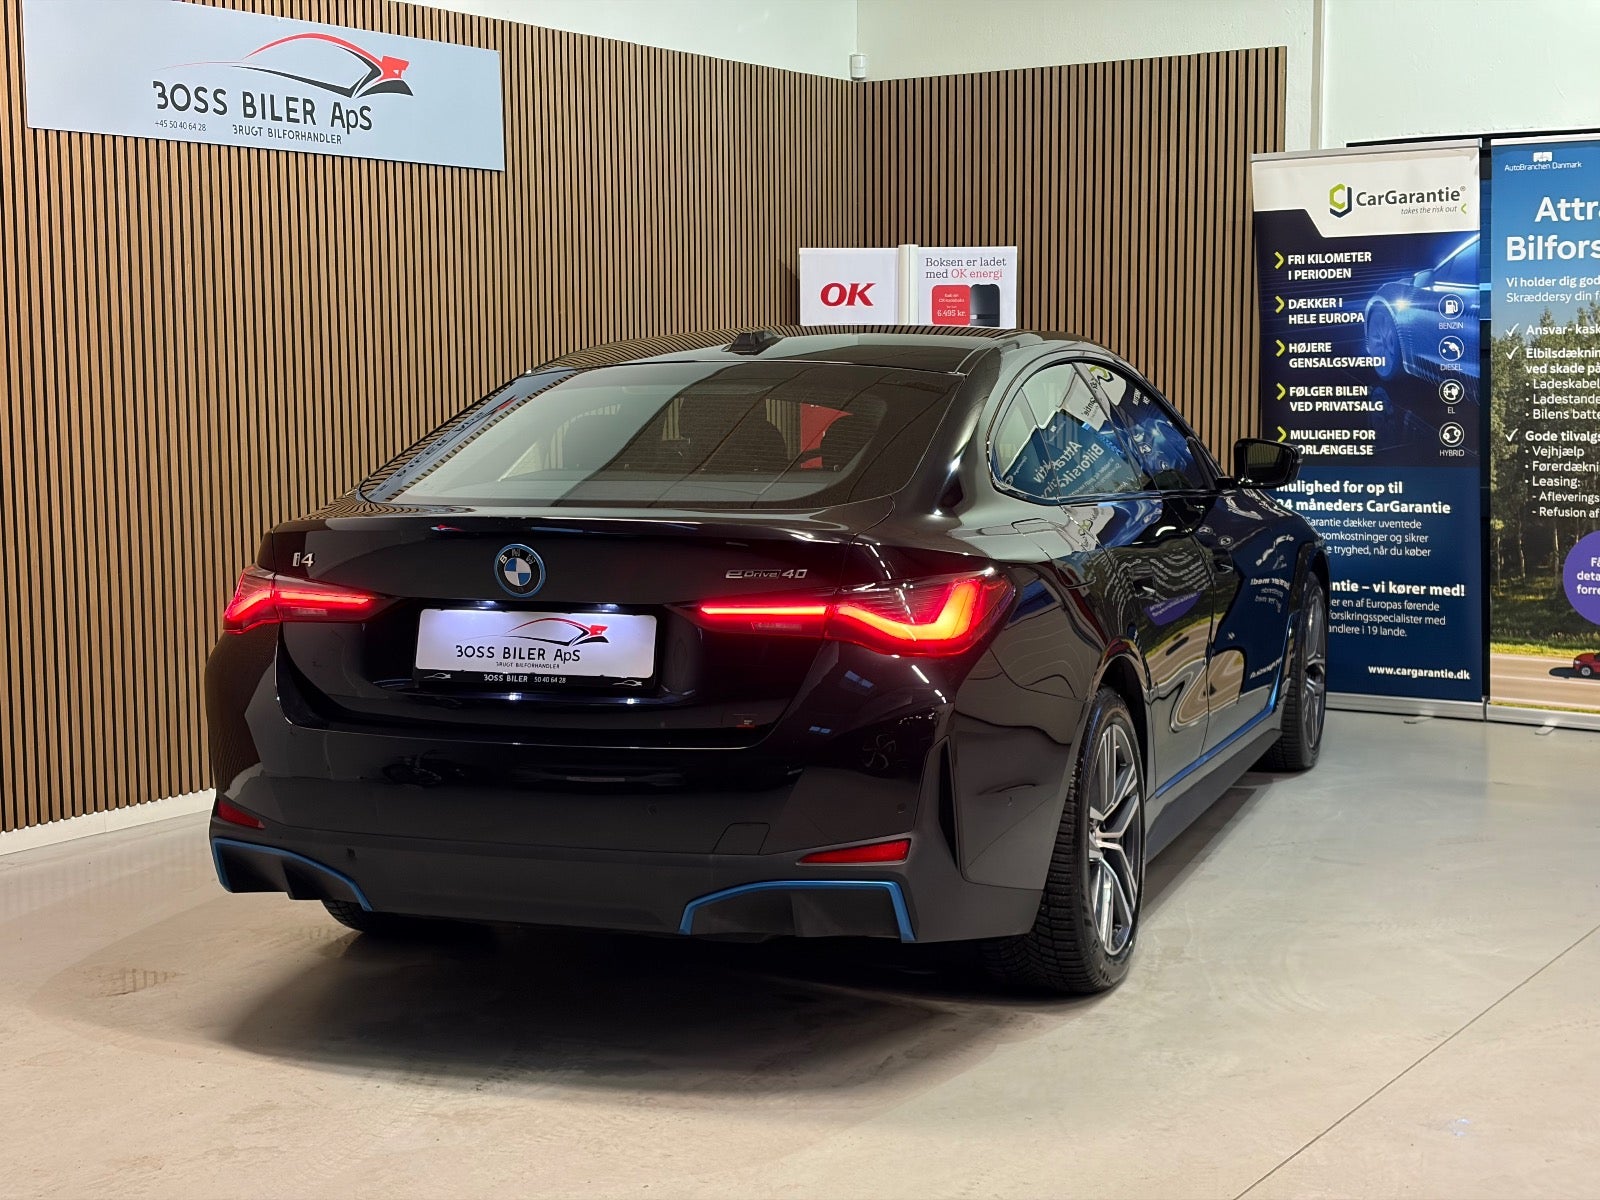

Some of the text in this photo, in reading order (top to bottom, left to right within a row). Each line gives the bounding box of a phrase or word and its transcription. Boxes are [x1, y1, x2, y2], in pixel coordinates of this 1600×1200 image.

[242, 91, 317, 126] BILER
[330, 101, 373, 135] ApS
[169, 120, 178, 129] 50
[178, 121, 187, 130] 40
[188, 122, 197, 131] 64
[198, 123, 207, 132] 28
[268, 127, 342, 145] BILFORHANDLER
[1504, 161, 1582, 172] AutoBranchen Danmark
[1420, 206, 1431, 214] the
[1432, 205, 1444, 214] risk
[1445, 205, 1457, 213] out
[1534, 196, 1600, 223] Attr
[926, 256, 1007, 267] Boksen er ladet
[1287, 251, 1372, 265] FRI KILOMETER
[926, 268, 1003, 281] med OK energi
[1288, 268, 1352, 281] I PERIODEN
[1505, 277, 1518, 288] Vi
[1520, 276, 1557, 287] holder
[1559, 275, 1577, 289] dig
[820, 282, 876, 307] OK
[1506, 291, 1572, 304] Skræddersy
[1574, 291, 1593, 302] din
[1288, 298, 1343, 309] DÆKKER I
[1288, 313, 1365, 325] HELE EUROPA
[1438, 322, 1464, 330] BENZIN
[1289, 342, 1332, 353] HØJERE
[1289, 356, 1386, 368] GENSALGSVÆRDI
[1440, 363, 1463, 371] DIESEL
[1525, 363, 1547, 374] ved
[1550, 362, 1585, 374] skade
[1289, 385, 1368, 397] FØLGER BILEN
[1290, 400, 1384, 412] VED PRIVATSALG
[1447, 406, 1455, 414] EL
[1532, 408, 1570, 420] Bilens
[1290, 429, 1376, 440] MULIGHED FOR
[1525, 430, 1558, 442] Gode
[1439, 449, 1465, 457] HYBRID
[1532, 446, 1585, 459] Vejhjælp
[1343, 480, 1364, 493] for
[1367, 483, 1385, 496] op
[1388, 481, 1403, 494] til
[1532, 475, 1581, 489] Leasing:
[1539, 491, 1600, 504] Afleverings
[1295, 497, 1364, 512] måneders
[1366, 500, 1451, 514] CarGarantie
[1539, 507, 1599, 519] Refusion af
[1343, 518, 1377, 528] dækker
[1378, 519, 1422, 530] uventede
[1390, 534, 1402, 545] og
[1404, 532, 1429, 543] sikrer
[1333, 545, 1372, 557] tryghed,
[1373, 545, 1388, 556] når
[1390, 546, 1403, 556] du
[1404, 546, 1432, 557] køber
[292, 552, 314, 567] i4
[1372, 580, 1385, 593] vi
[1389, 580, 1426, 595] kører
[1429, 583, 1466, 597] med!
[1331, 597, 1440, 612] er en af Europas førende
[1424, 615, 1446, 626] med
[1367, 625, 1378, 636] 19
[1380, 626, 1408, 637] lande.
[502, 646, 546, 661] BILER
[554, 648, 581, 664] ApS
[506, 674, 528, 683] BILER
[1368, 665, 1471, 680] www.cargarantie.dk
